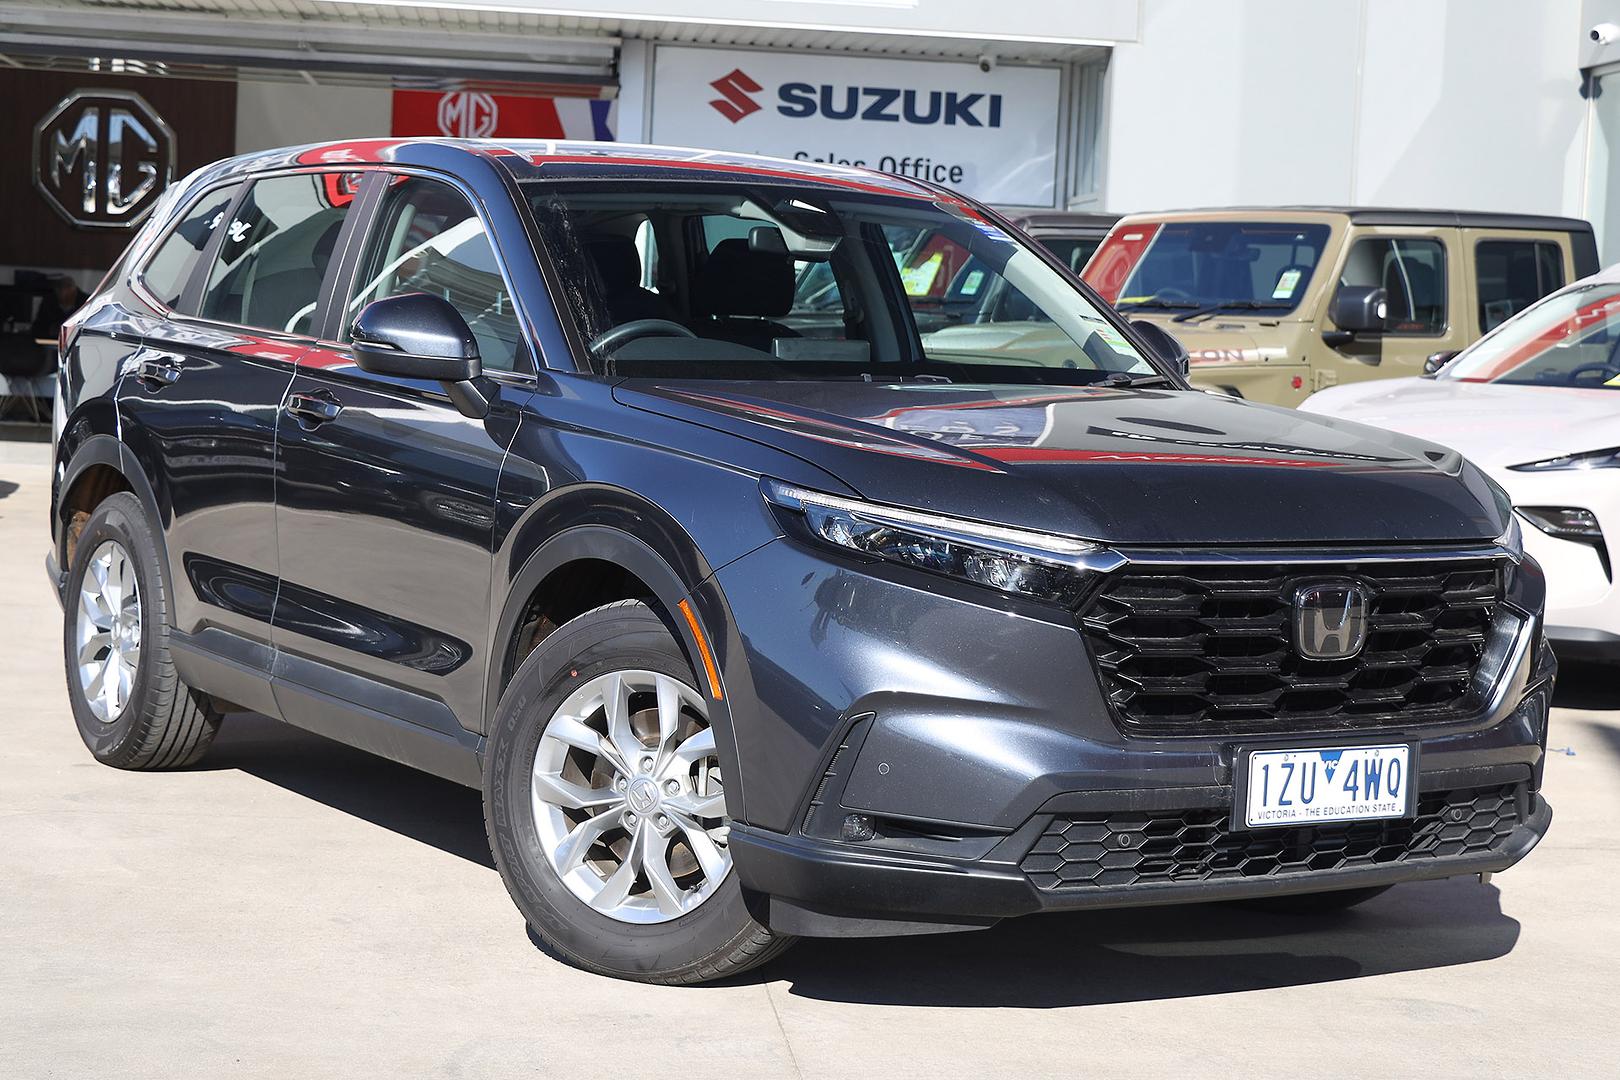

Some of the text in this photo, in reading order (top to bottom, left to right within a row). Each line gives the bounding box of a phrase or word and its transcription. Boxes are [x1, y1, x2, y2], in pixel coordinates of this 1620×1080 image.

[444, 91, 492, 138] MG
[776, 82, 1003, 128] SUZUKI
[51, 107, 158, 215] MG
[878, 156, 964, 184] Office
[1262, 757, 1401, 807] 1ZU 4WQ
[1257, 809, 1297, 820] VICTORIA
[1305, 807, 1321, 817] THE
[1323, 804, 1371, 816] EDUCATION
[1372, 802, 1397, 813] STATE
